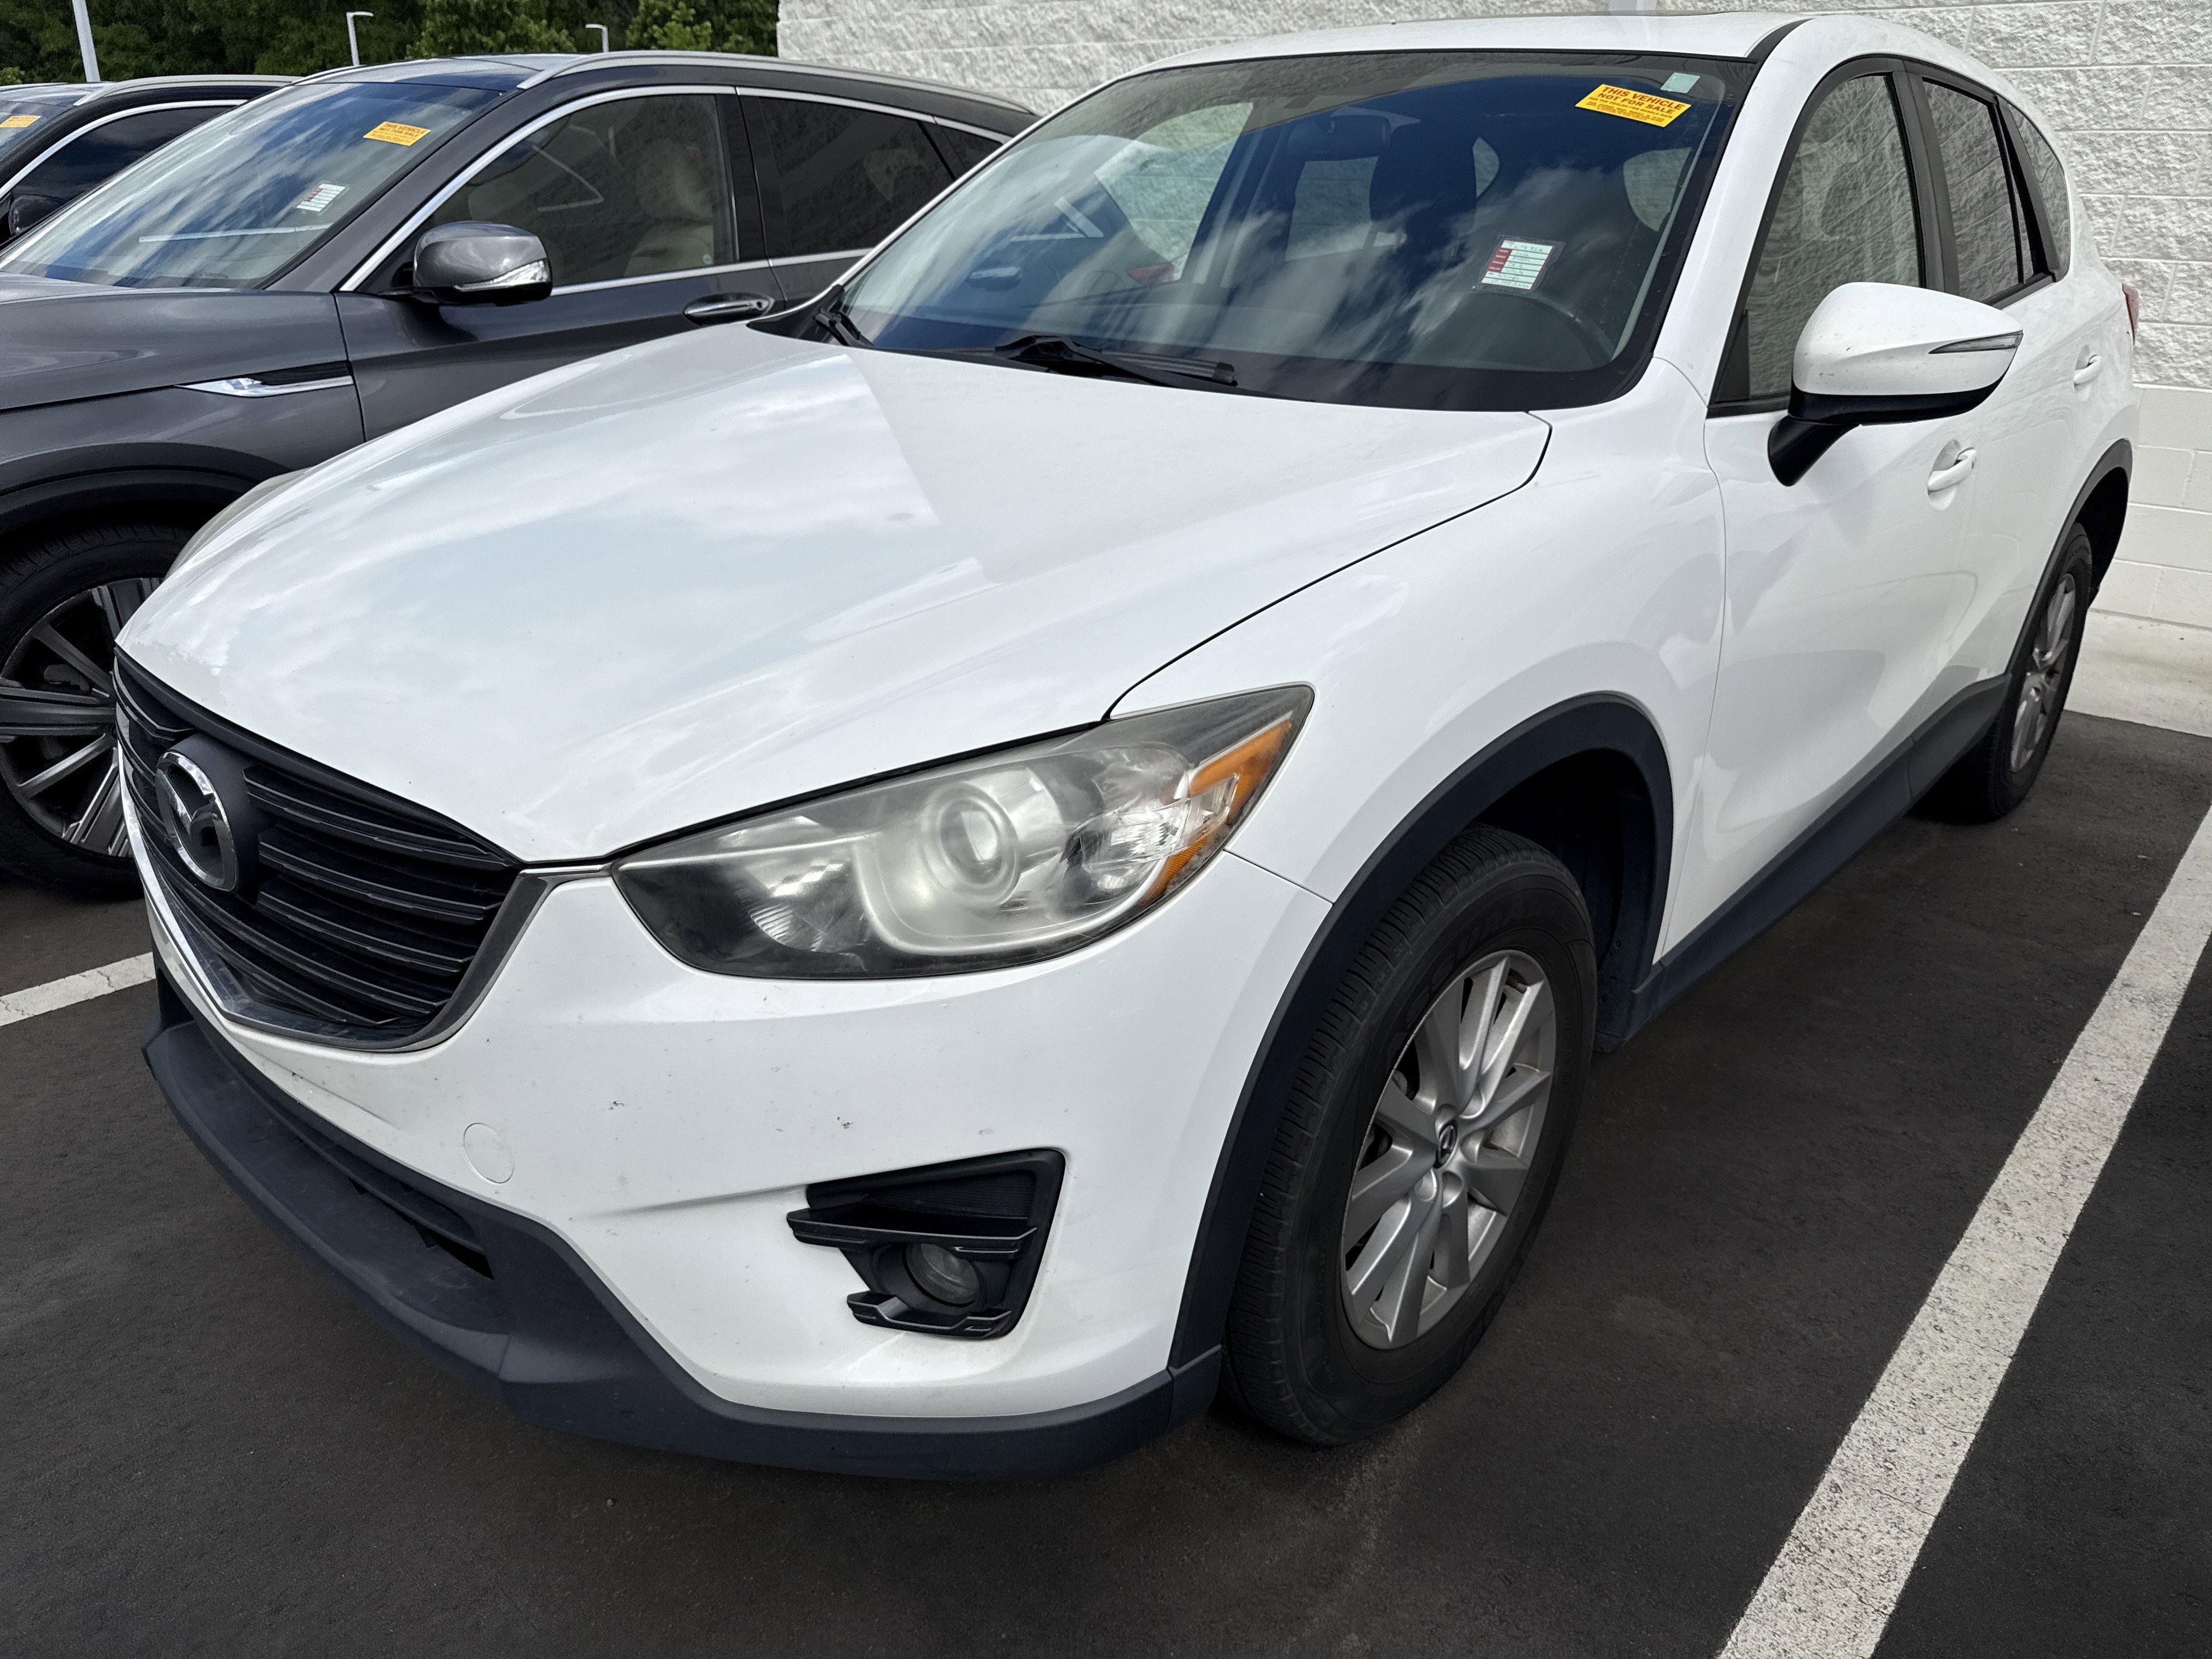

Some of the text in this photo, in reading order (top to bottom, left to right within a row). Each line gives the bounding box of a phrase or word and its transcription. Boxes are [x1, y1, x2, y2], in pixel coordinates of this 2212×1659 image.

[1602, 87, 1685, 110] THIS VEHICLE
[1621, 98, 1644, 107] FOR
[1645, 104, 1675, 115] SALE
